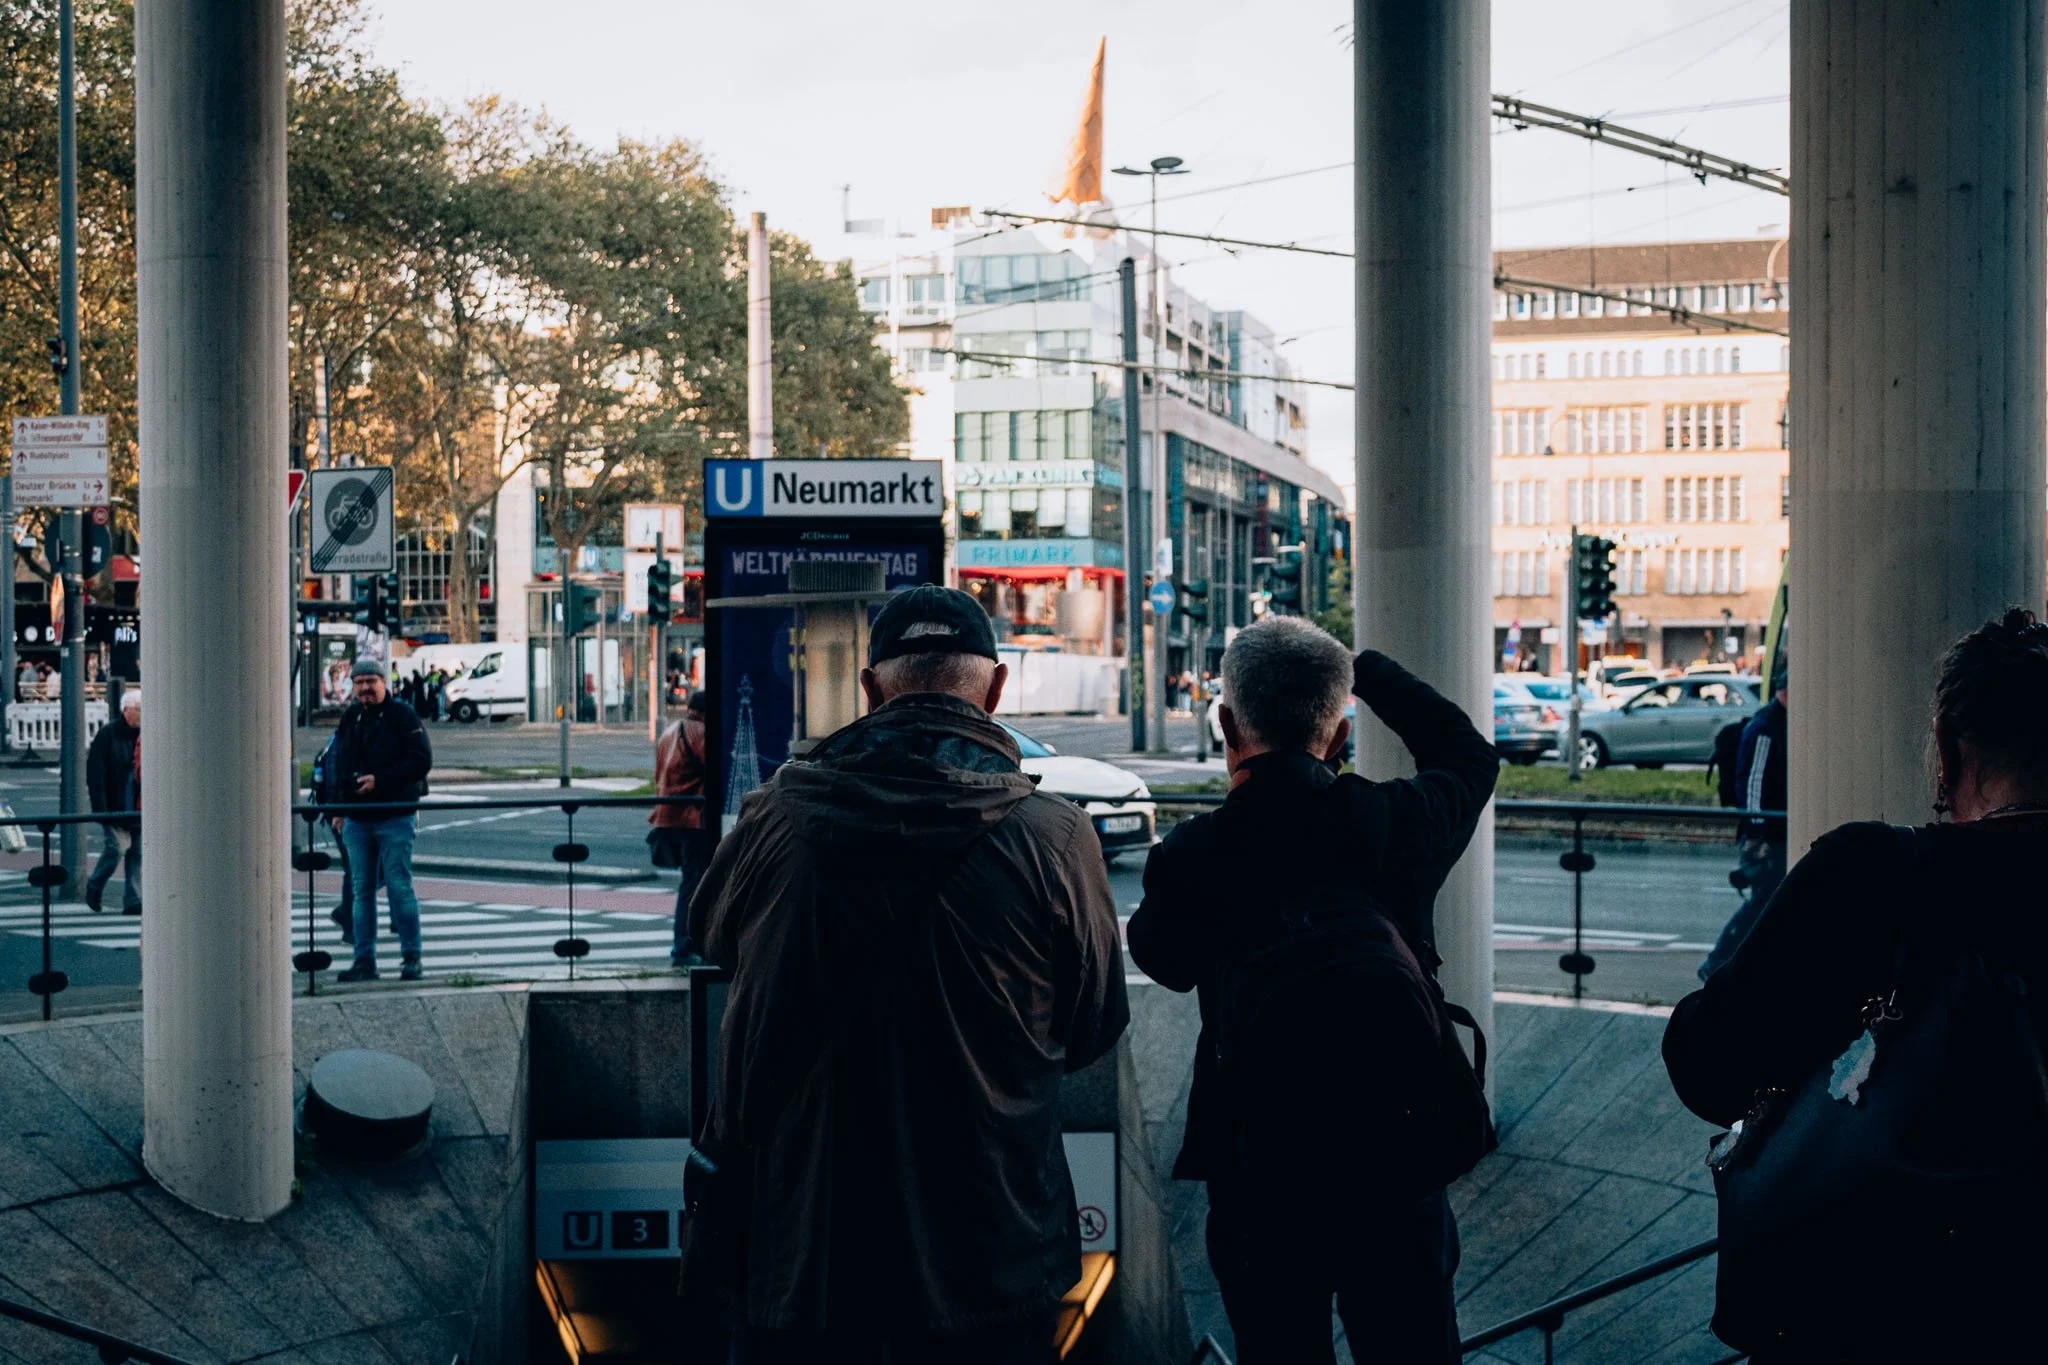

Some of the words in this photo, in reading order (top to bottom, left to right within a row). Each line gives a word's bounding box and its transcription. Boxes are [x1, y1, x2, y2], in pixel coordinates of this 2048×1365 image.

[30, 452, 69, 461] Rudolfplatz
[15, 481, 45, 490] Deutzer
[49, 480, 76, 490] Brücke
[715, 467, 751, 511] U
[773, 472, 934, 504] Neumarkt
[15, 494, 54, 503] Heumarkt
[971, 545, 1077, 563] PRIMARK
[568, 1215, 599, 1246] U
[633, 1218, 649, 1242] 3
